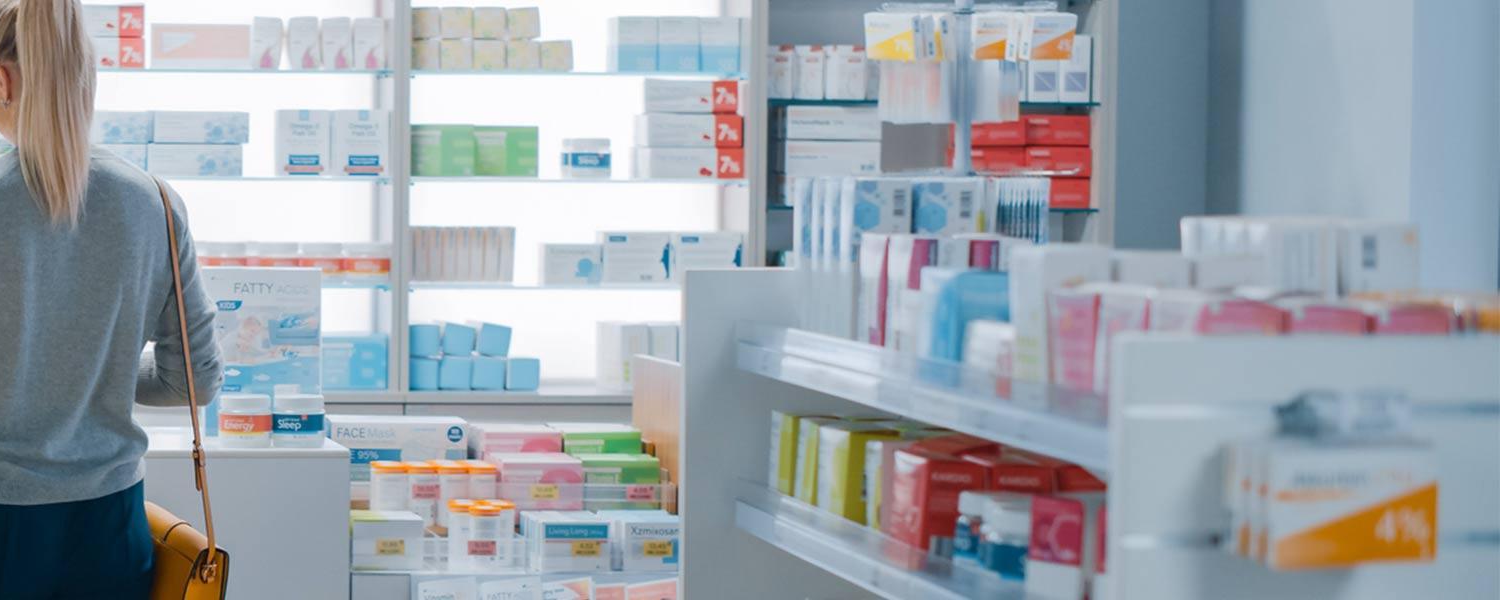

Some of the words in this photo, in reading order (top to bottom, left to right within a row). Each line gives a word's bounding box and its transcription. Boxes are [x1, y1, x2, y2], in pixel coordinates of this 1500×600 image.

[122, 12, 141, 30] 7%
[122, 46, 141, 64] 7%
[716, 86, 736, 105] 7%
[718, 123, 738, 141] 7%
[720, 155, 740, 174] 7%
[233, 282, 274, 294] FATTY
[224, 419, 255, 432] Energy
[277, 418, 302, 432] Sleep
[336, 427, 366, 439] FACE
[357, 450, 379, 460] 95%
